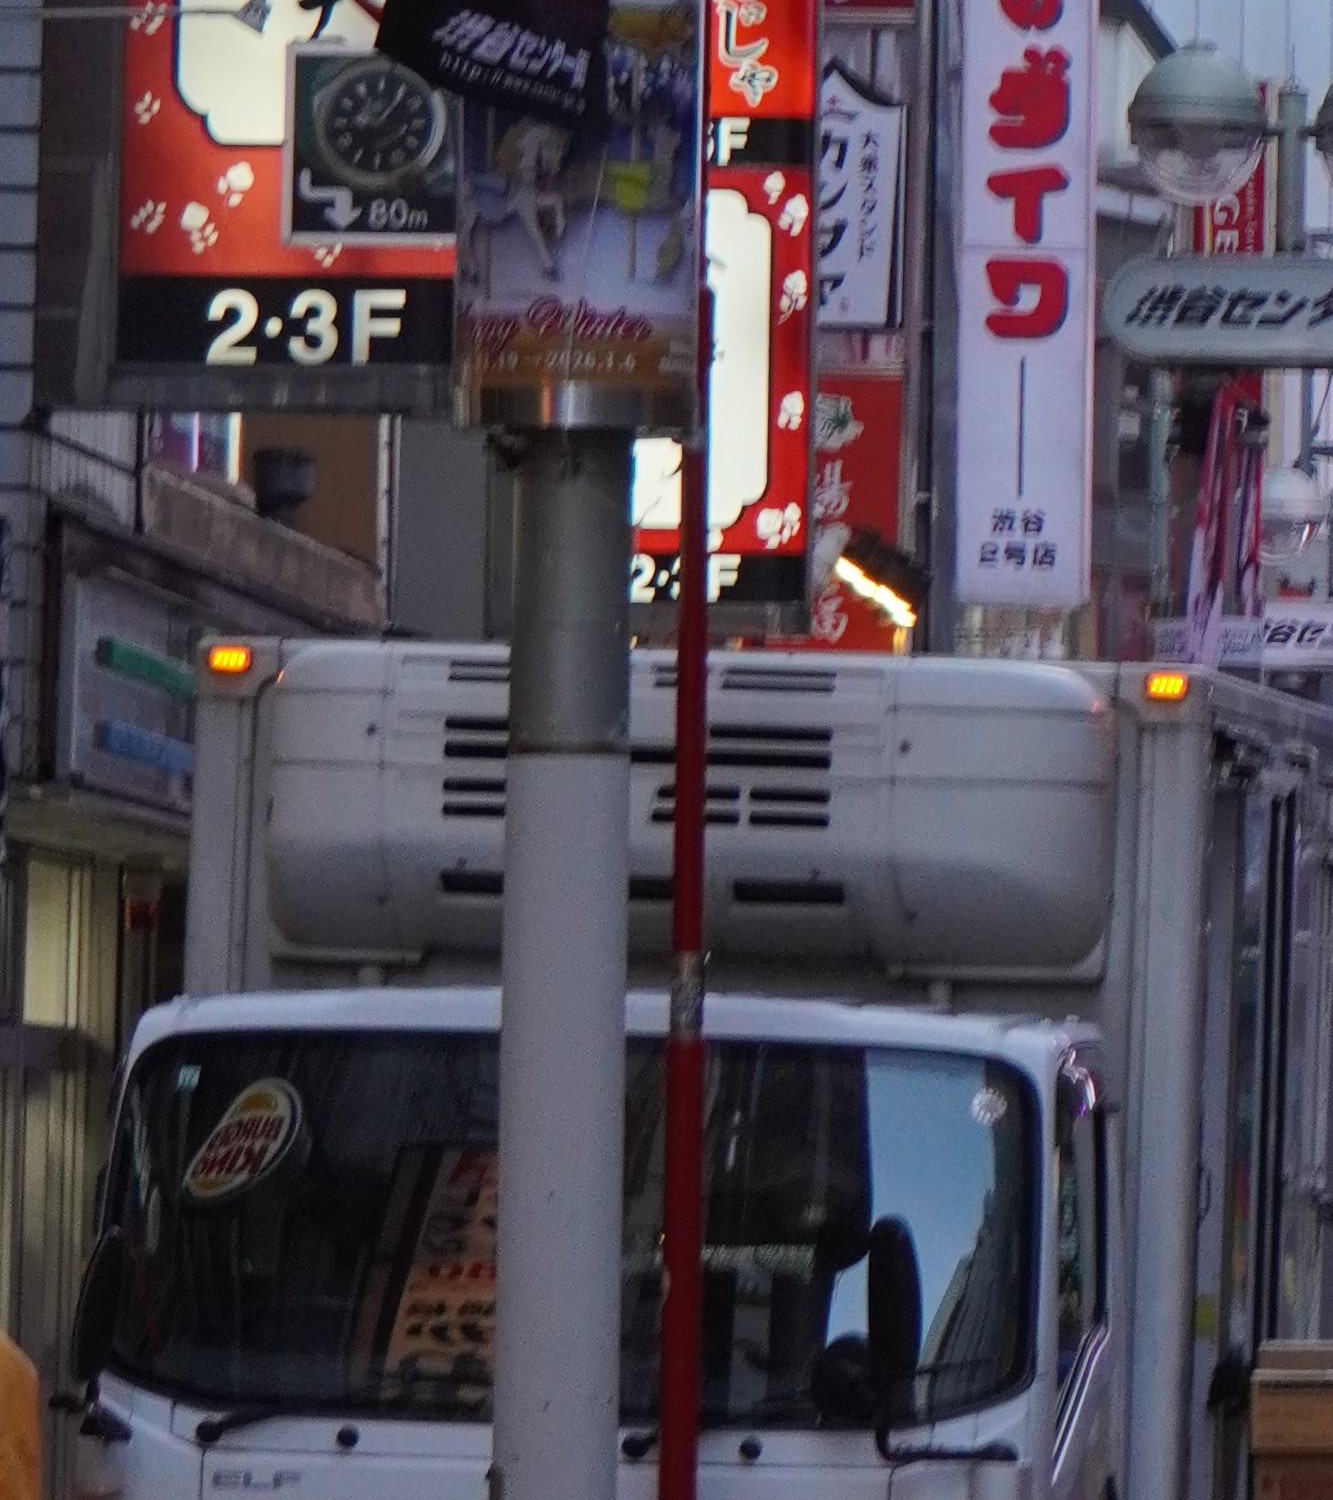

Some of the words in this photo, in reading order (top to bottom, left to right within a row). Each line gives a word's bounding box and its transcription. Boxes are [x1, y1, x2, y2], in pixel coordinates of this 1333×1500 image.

[367, 202, 429, 231] 80m
[991, 508, 1046, 536] 渋谷
[978, 540, 1058, 571] 2号店
[632, 553, 742, 603] 2・F
[211, 1469, 303, 1490] ELF
